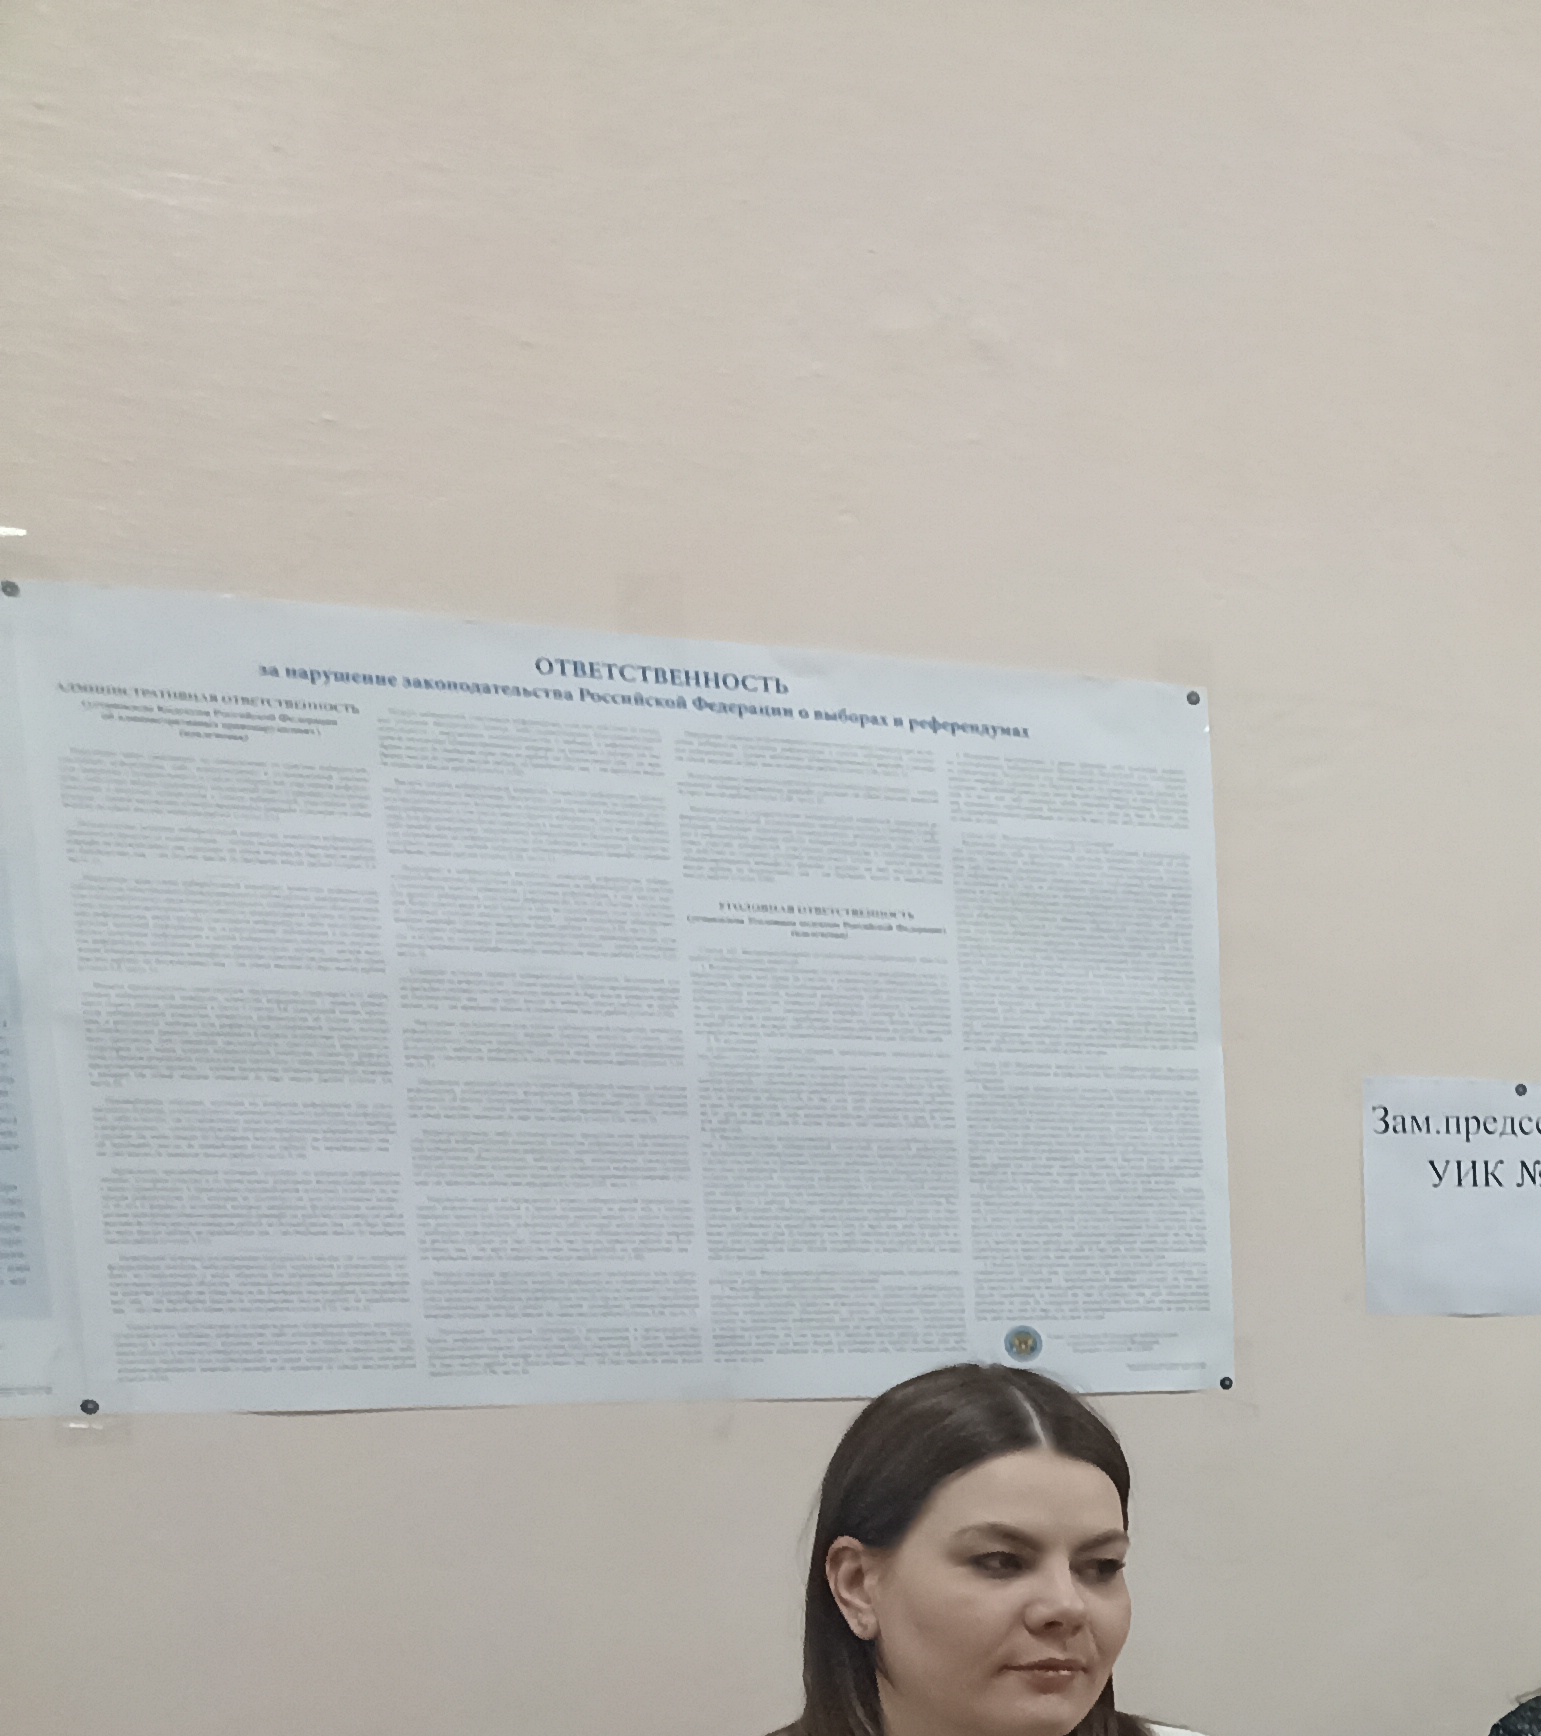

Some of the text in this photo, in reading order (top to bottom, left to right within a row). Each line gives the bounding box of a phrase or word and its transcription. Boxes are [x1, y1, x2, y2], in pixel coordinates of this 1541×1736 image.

[535, 656, 789, 694] ОТВЕТСТВЕННОСТЬ
[258, 664, 280, 678] за
[285, 666, 397, 687] нарушение
[402, 675, 573, 702] законодательства
[579, 686, 687, 710] Российской
[692, 695, 793, 719] Федерации
[814, 708, 888, 729] выборах
[909, 716, 1030, 740] референдумах
[1428, 1159, 1505, 1188] УИК
